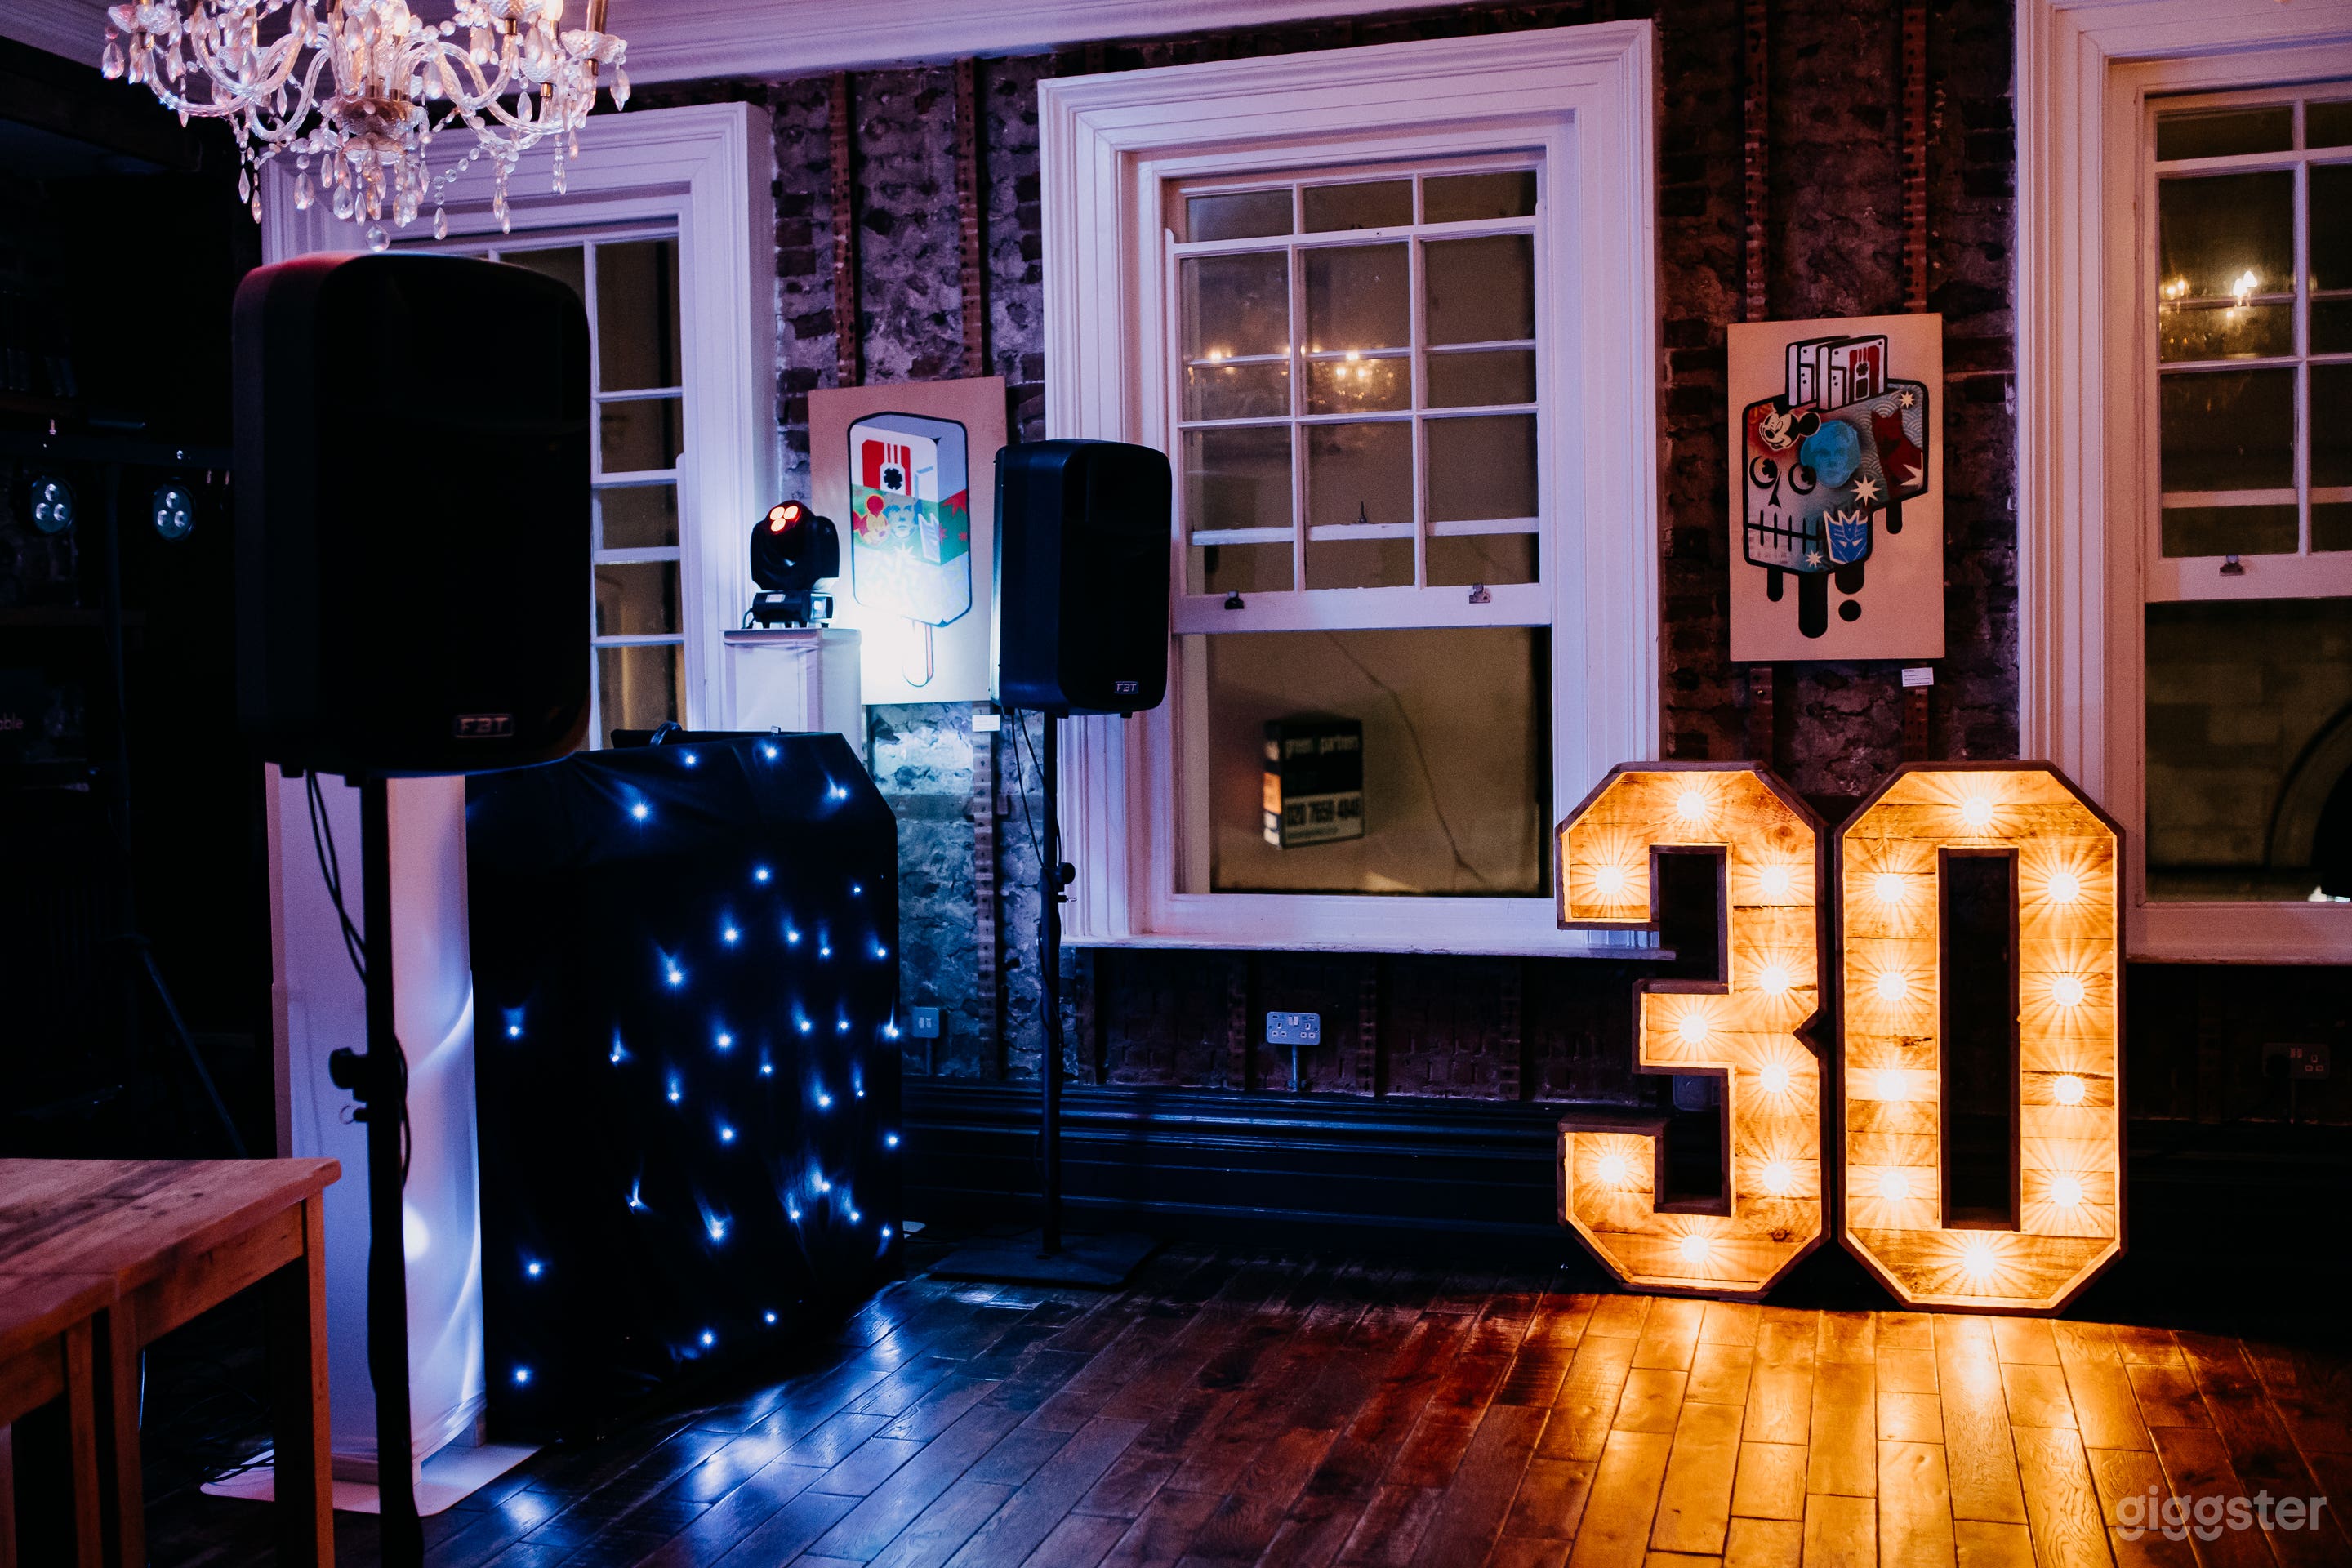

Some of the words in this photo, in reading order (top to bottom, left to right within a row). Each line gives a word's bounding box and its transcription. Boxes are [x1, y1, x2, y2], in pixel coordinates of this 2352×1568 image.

[1116, 683, 1137, 693] FBT
[459, 717, 509, 733] FBT
[1556, 760, 2127, 1316] 30
